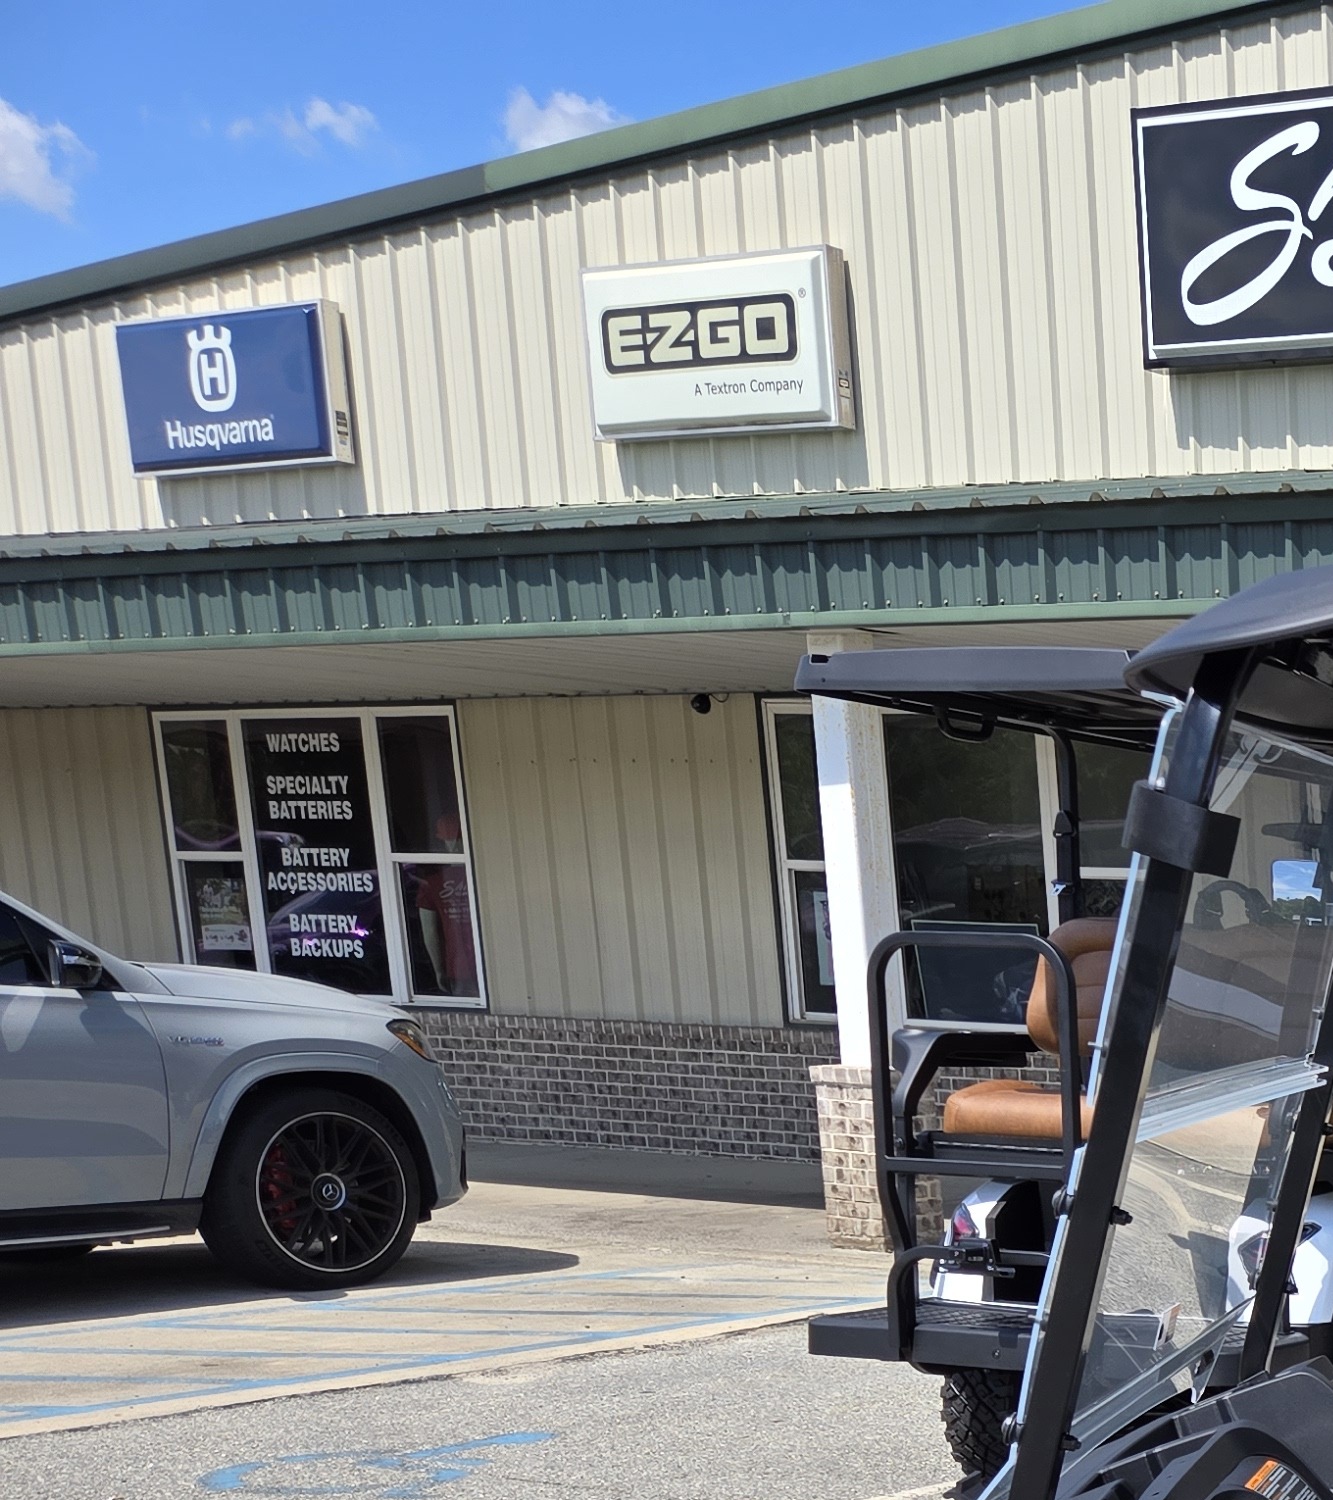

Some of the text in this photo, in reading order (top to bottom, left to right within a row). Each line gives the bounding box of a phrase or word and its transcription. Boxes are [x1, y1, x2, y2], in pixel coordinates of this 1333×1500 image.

[695, 379, 803, 396] A Textron Company
[165, 418, 275, 450] Husqvarna
[266, 733, 340, 753] WATCHES
[266, 776, 349, 795] SPECIALTY
[268, 800, 353, 820] BATTERIES
[281, 848, 350, 867] BATTERY
[268, 872, 374, 893] ACCESSORIES
[289, 913, 358, 933] BATTERY
[291, 938, 364, 958] BACKUPS
